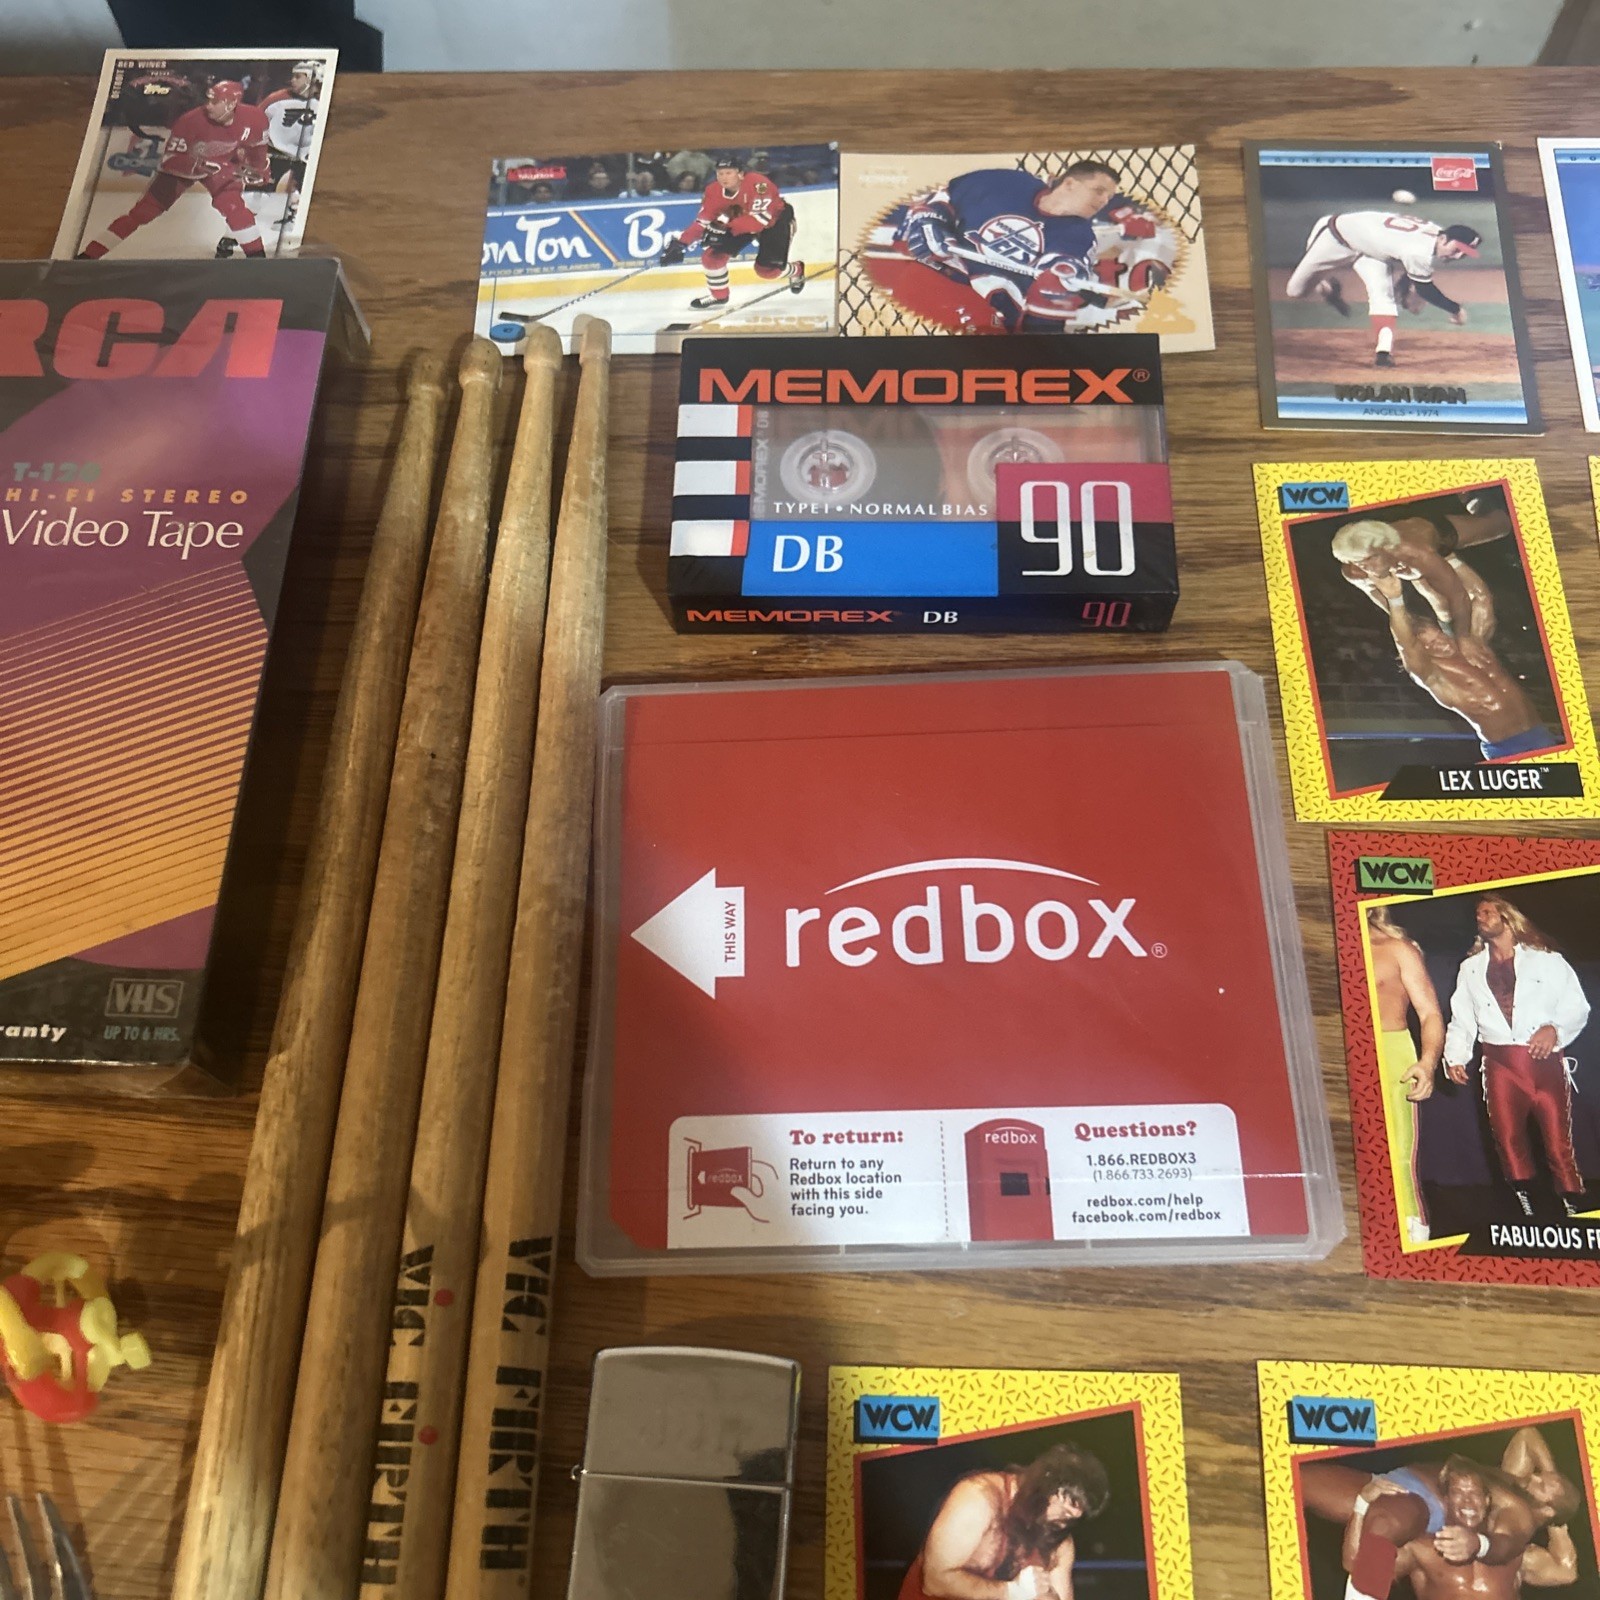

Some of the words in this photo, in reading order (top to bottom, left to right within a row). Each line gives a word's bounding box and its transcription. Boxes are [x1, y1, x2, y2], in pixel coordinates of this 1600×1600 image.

[752, 199, 772, 211] 27
[1362, 407, 1406, 417] ANGELS
[13, 461, 101, 482] T-120
[5, 487, 96, 502] HI-FI
[120, 488, 248, 504] STEREO
[849, 502, 938, 517] NORMAL
[942, 503, 989, 517] BIAS
[2, 507, 130, 547] Video
[143, 510, 244, 560] Tape
[1019, 480, 1136, 577] 90
[772, 534, 844, 573] DB
[685, 609, 895, 624] MEMOREX
[922, 610, 959, 624] DB
[1081, 601, 1132, 628] 90
[1438, 770, 1474, 791] LEX
[724, 900, 737, 927] WAY
[724, 930, 737, 963] THIS
[114, 983, 180, 1014] VHS
[104, 1026, 121, 1041] UP
[124, 1026, 139, 1041] TO
[789, 1130, 817, 1146] To
[822, 1129, 904, 1145] return:
[984, 1130, 1038, 1145] redbox
[1074, 1120, 1198, 1142] Questions?
[789, 1158, 837, 1171] Return
[841, 1158, 855, 1170] to
[859, 1158, 885, 1171] any
[1086, 1151, 1197, 1167] 1.866.REDBOX3
[789, 1173, 842, 1186] Redbox
[846, 1172, 902, 1185] location
[790, 1188, 820, 1201] with
[823, 1187, 850, 1200] this
[854, 1187, 883, 1200] side
[1086, 1193, 1204, 1209] redbox.com/help
[790, 1203, 835, 1218] facing
[839, 1204, 869, 1218] you.
[1071, 1209, 1222, 1224] facebook.com/redbox
[1490, 1224, 1583, 1250] FABULOUS
[863, 1401, 938, 1432] WCW
[1295, 1402, 1376, 1435] WCW
